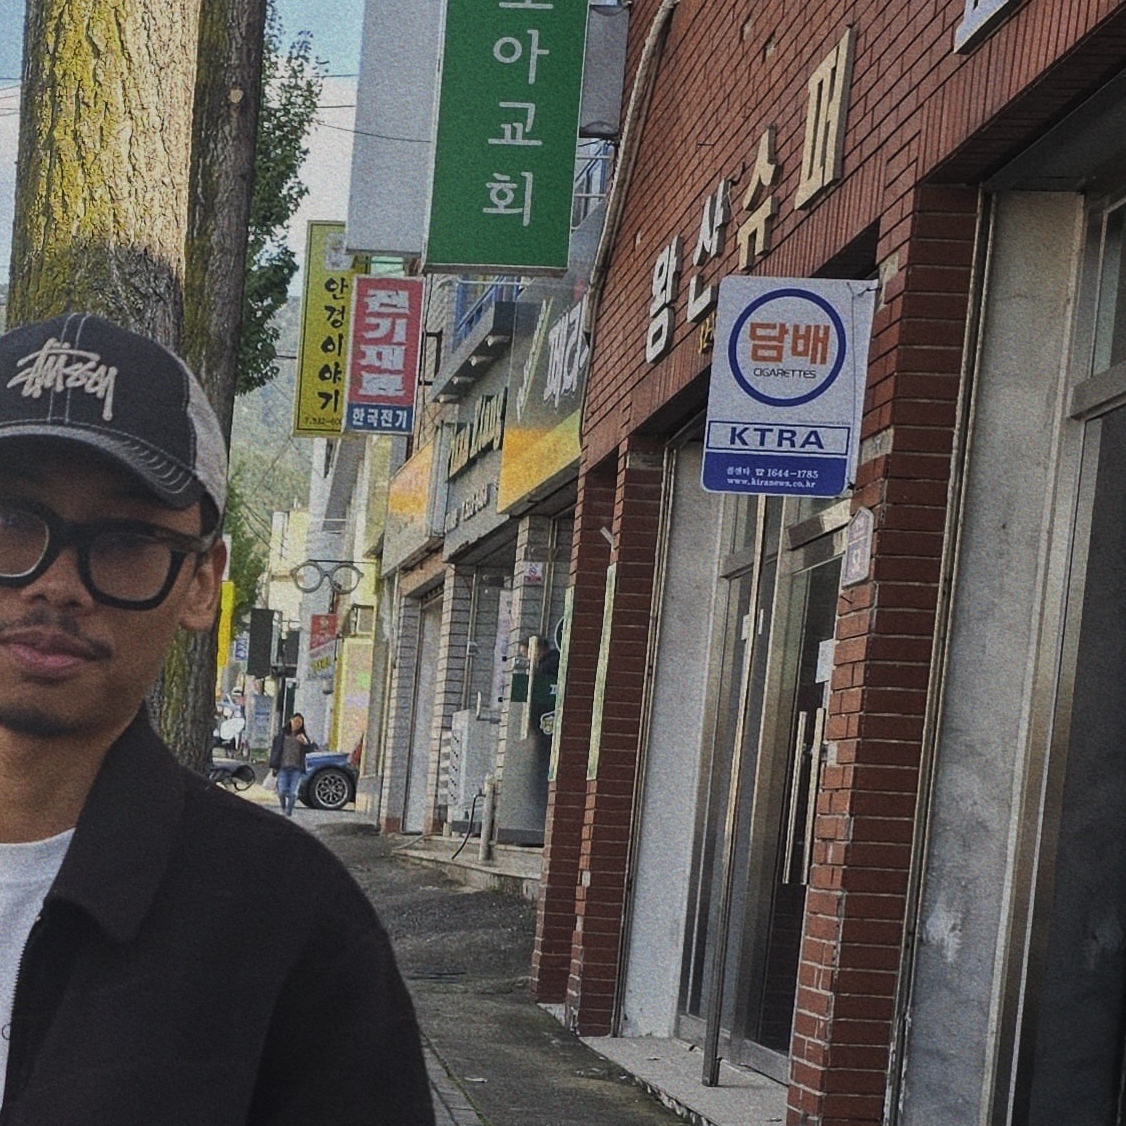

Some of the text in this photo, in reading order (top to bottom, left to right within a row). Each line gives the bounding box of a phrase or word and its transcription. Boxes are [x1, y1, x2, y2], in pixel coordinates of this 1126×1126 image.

[482, 0, 555, 227] 아교회
[317, 277, 349, 413] 안경이야기
[749, 322, 830, 366] 담배
[352, 406, 408, 429] 한국전기
[729, 426, 825, 450] KTRA
[766, 468, 819, 479] 1644-1785
